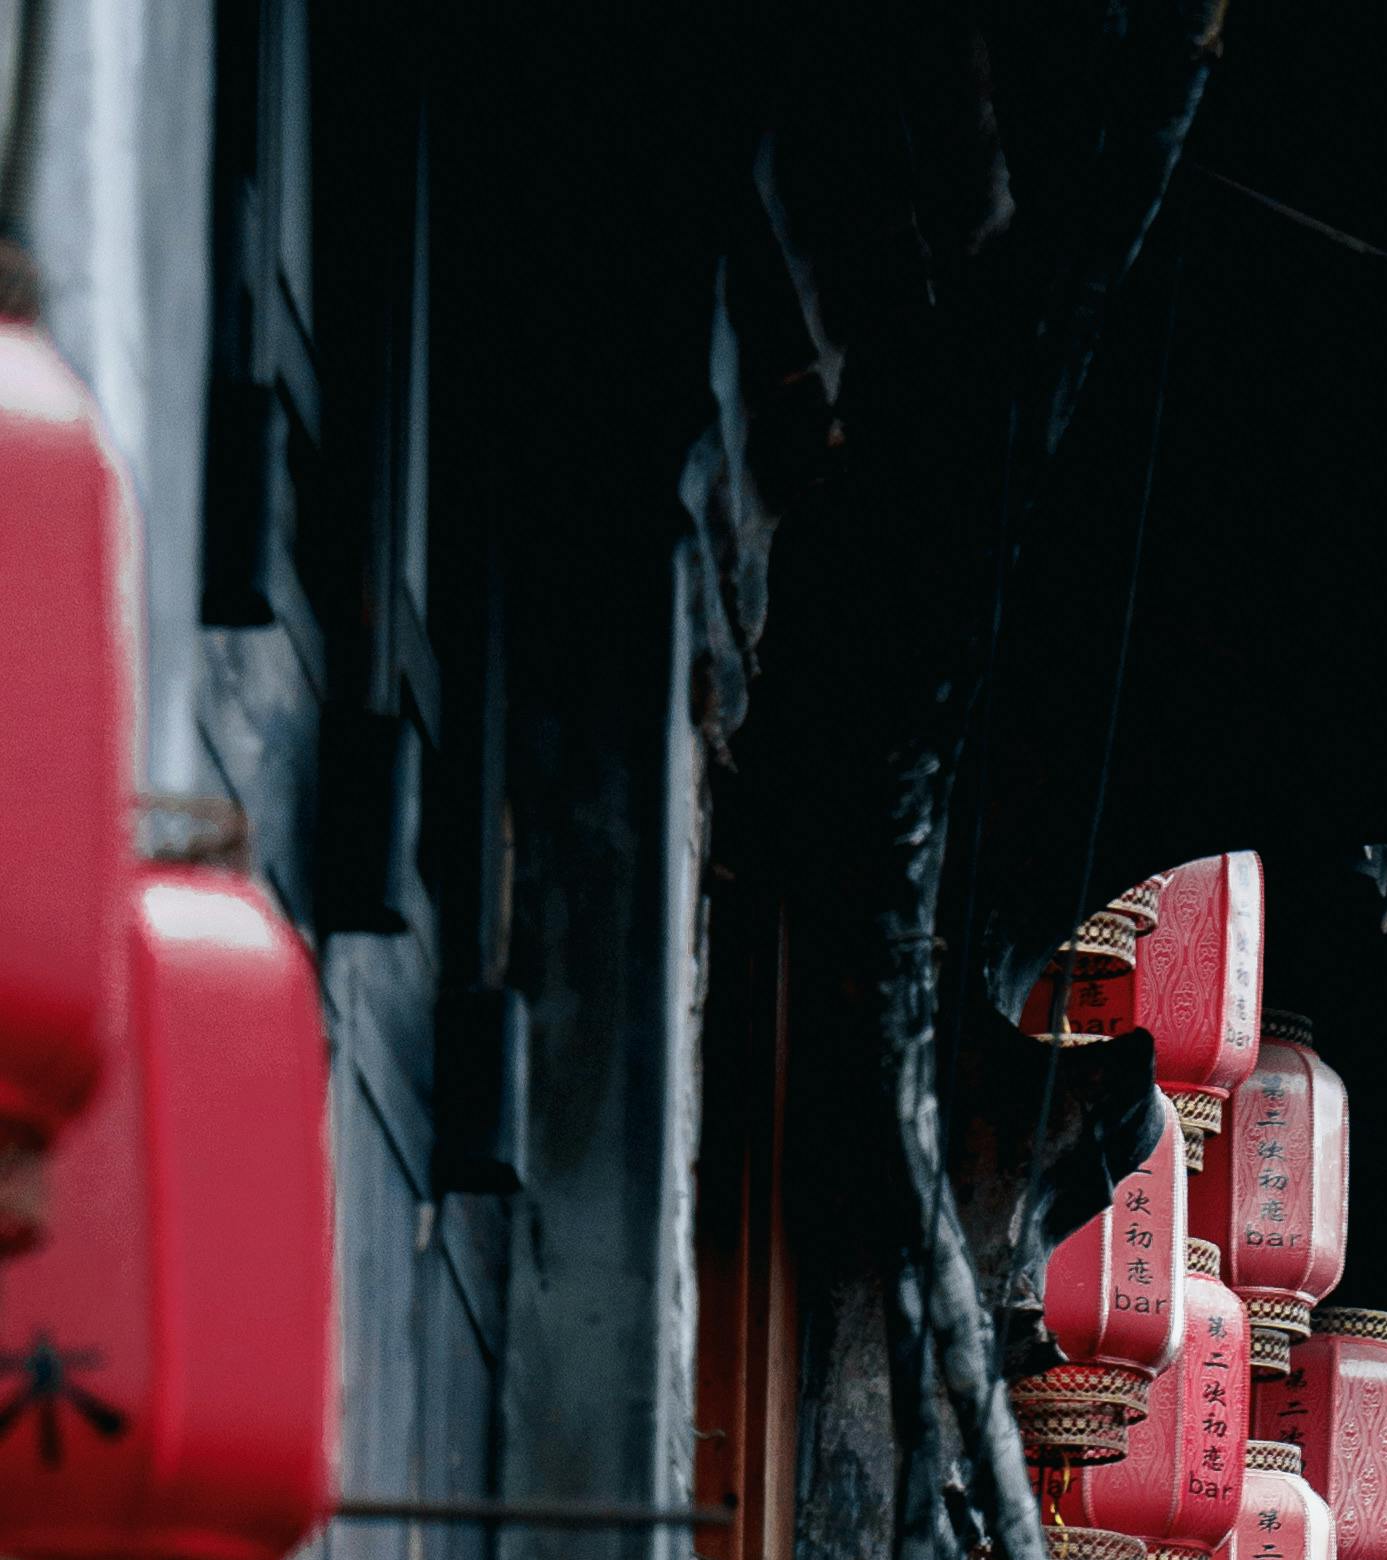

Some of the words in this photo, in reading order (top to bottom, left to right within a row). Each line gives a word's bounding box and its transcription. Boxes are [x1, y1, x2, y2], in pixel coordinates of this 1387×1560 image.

[1258, 1077, 1287, 1223] 第二次初恋
[1246, 1229, 1302, 1249] bar
[1114, 1287, 1168, 1314] bar
[1203, 1317, 1229, 1470] 第二次初恋
[1189, 1475, 1233, 1500] bar
